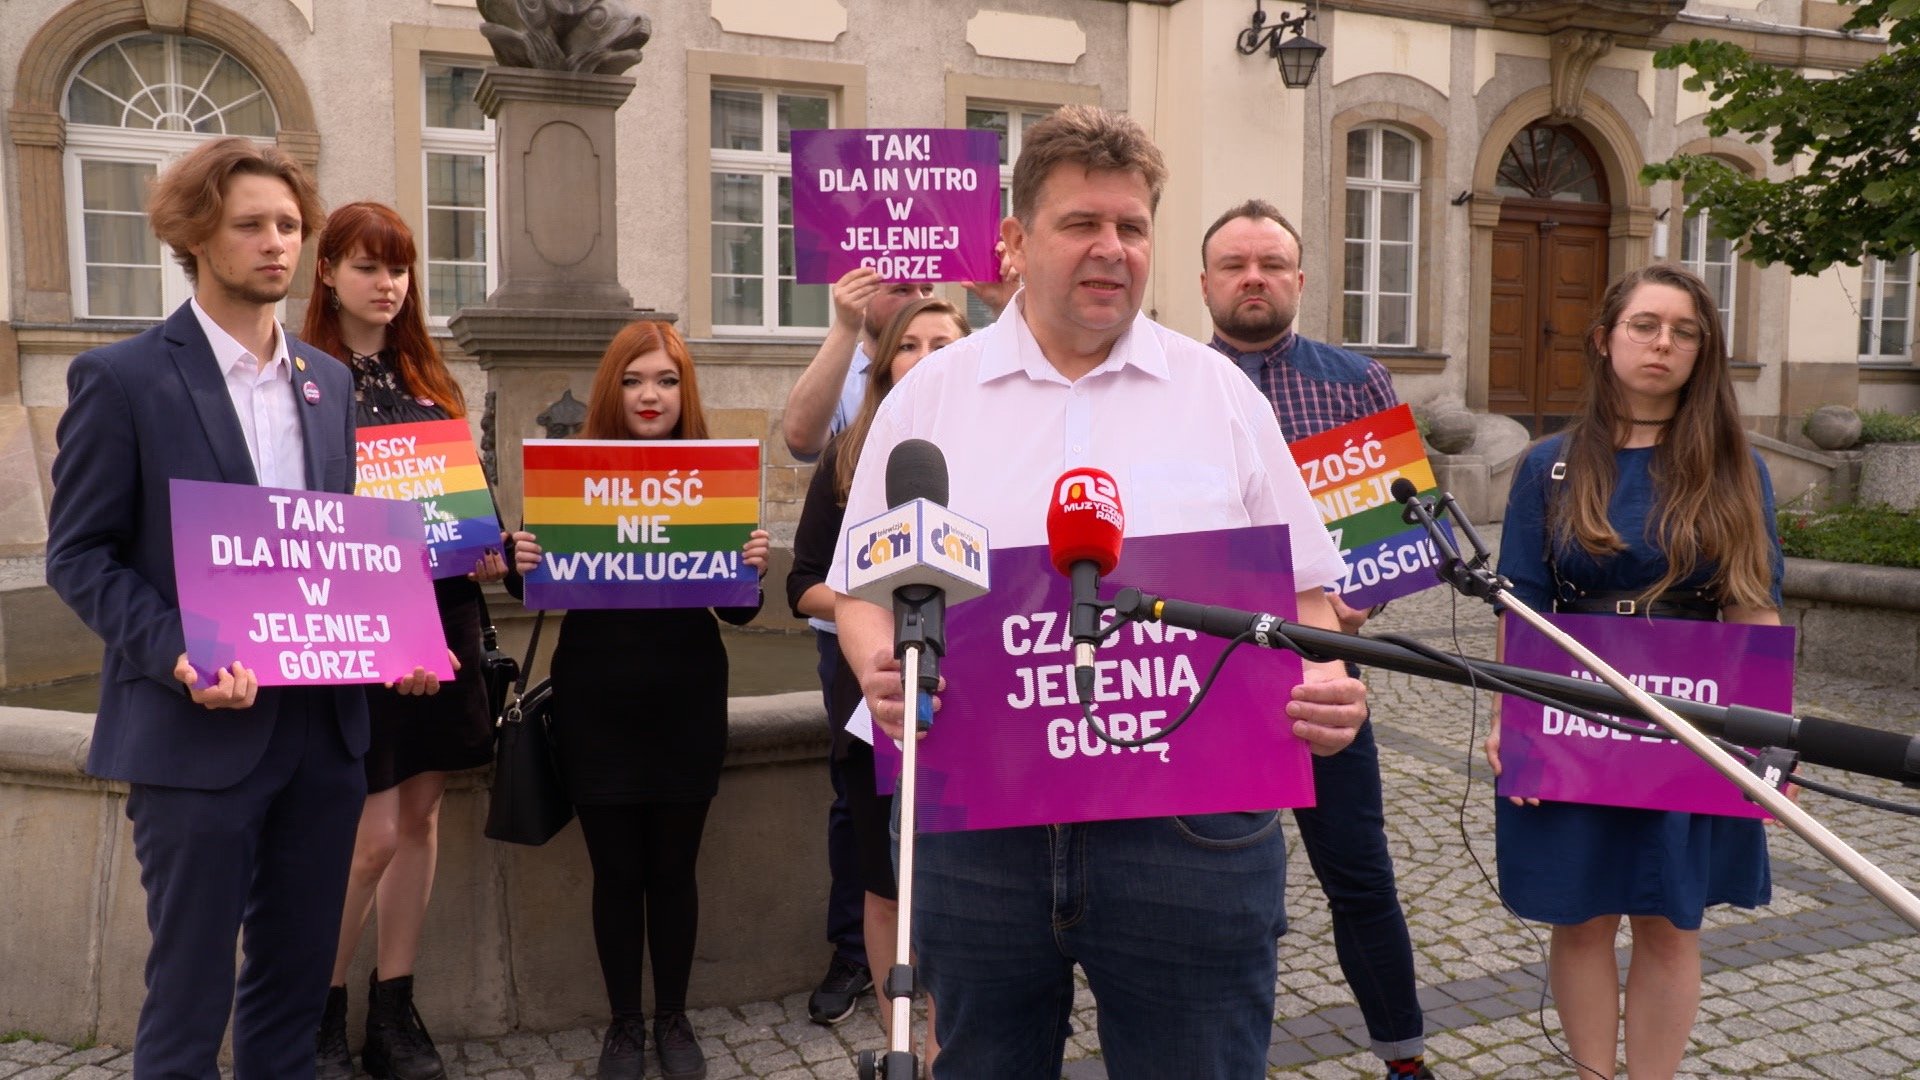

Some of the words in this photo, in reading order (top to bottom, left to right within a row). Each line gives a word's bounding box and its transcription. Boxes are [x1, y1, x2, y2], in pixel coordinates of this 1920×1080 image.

[866, 134, 931, 162] TAK!
[819, 168, 868, 192] DLA
[874, 167, 899, 191] IN
[904, 167, 977, 191] VITRO
[886, 197, 914, 221] W
[840, 226, 959, 250] JELENIEJ
[398, 478, 445, 501] SAM
[584, 469, 703, 507] MIŁOŚĆ
[269, 495, 345, 533] TAK!
[421, 501, 440, 521] K
[617, 515, 671, 544] NIE
[211, 535, 274, 567] DLA
[280, 539, 311, 569] IN
[316, 540, 401, 573] VITRO
[545, 550, 737, 581] WYKLUCZA!
[297, 577, 330, 606] W
[249, 613, 391, 643] JELENIEJ
[279, 643, 380, 680] GÓRZE
[1047, 703, 1170, 763] GÓRĘ
